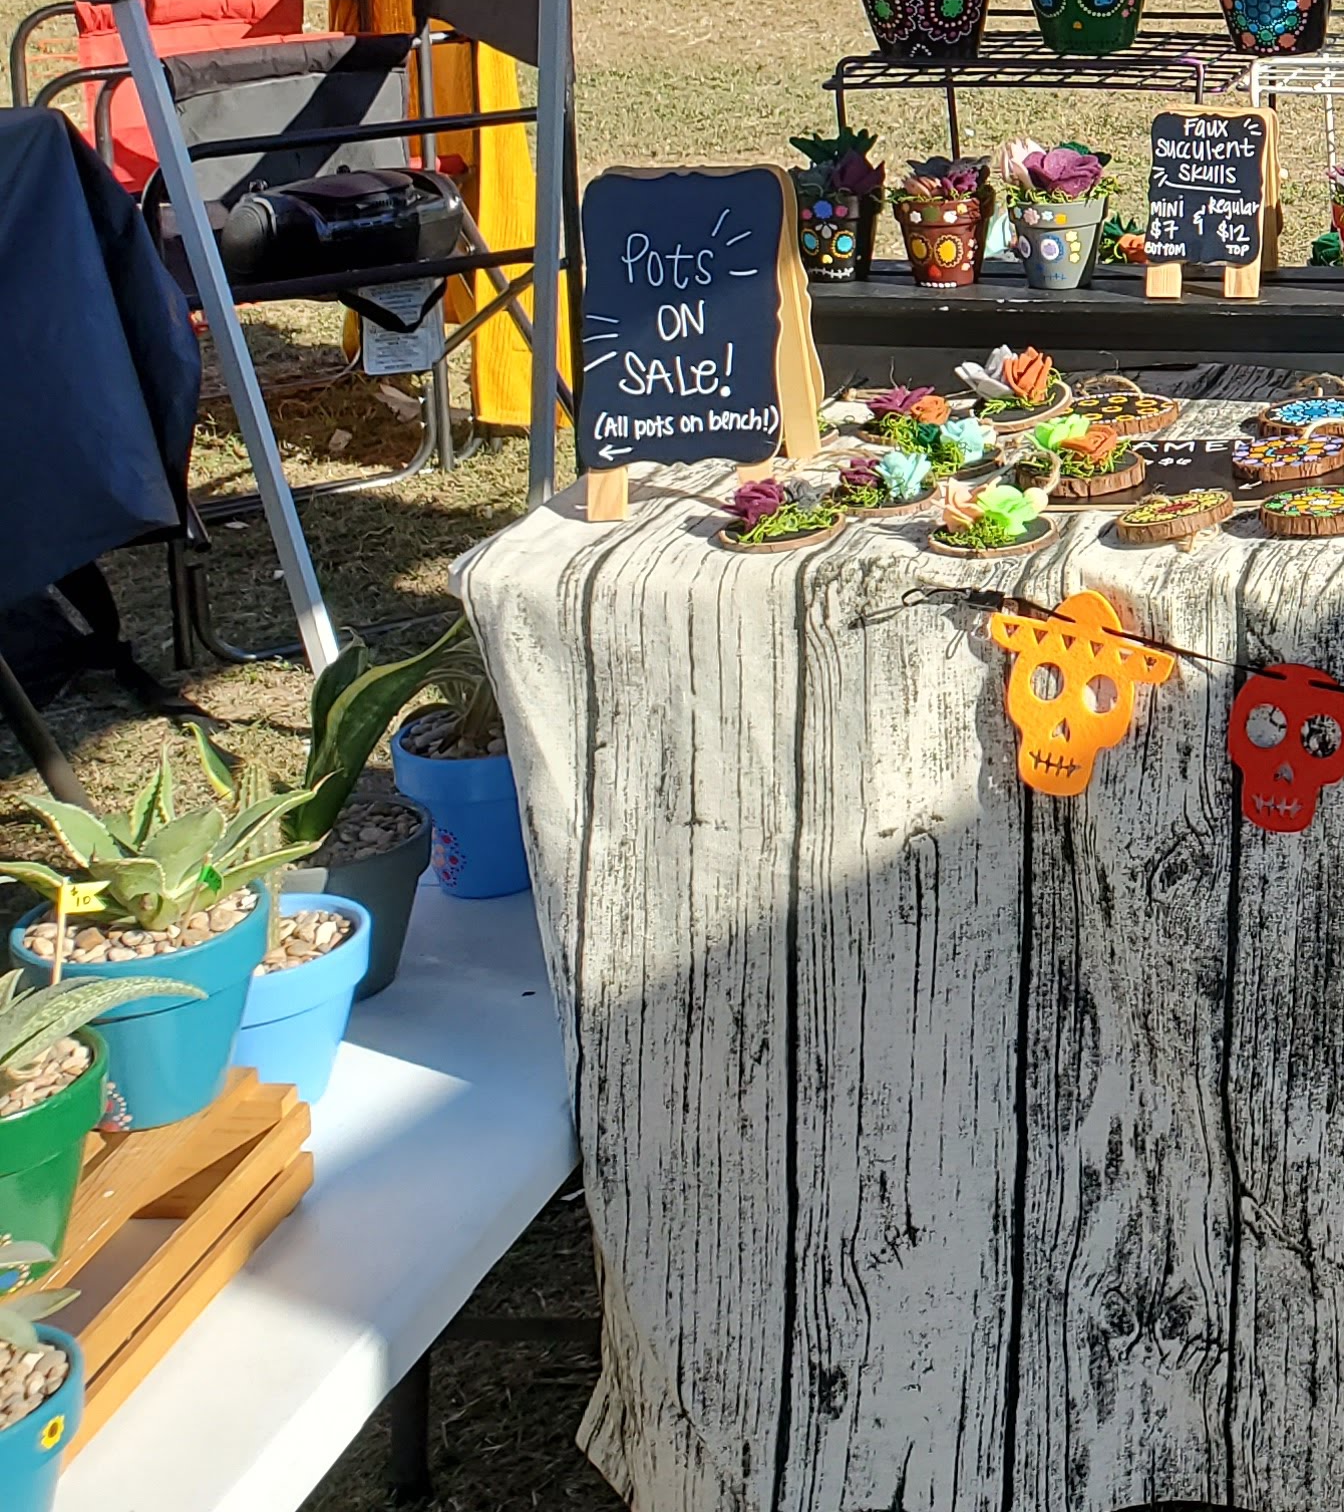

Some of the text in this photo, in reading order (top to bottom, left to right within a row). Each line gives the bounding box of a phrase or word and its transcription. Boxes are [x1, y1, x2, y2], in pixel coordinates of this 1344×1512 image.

[1150, 220, 1250, 243] $7 $12
[621, 232, 714, 289] Pots
[1225, 244, 1250, 256] TOP
[657, 300, 706, 341] ON
[594, 405, 779, 441] (All pots on bench!)
[71, 885, 91, 907] $10
